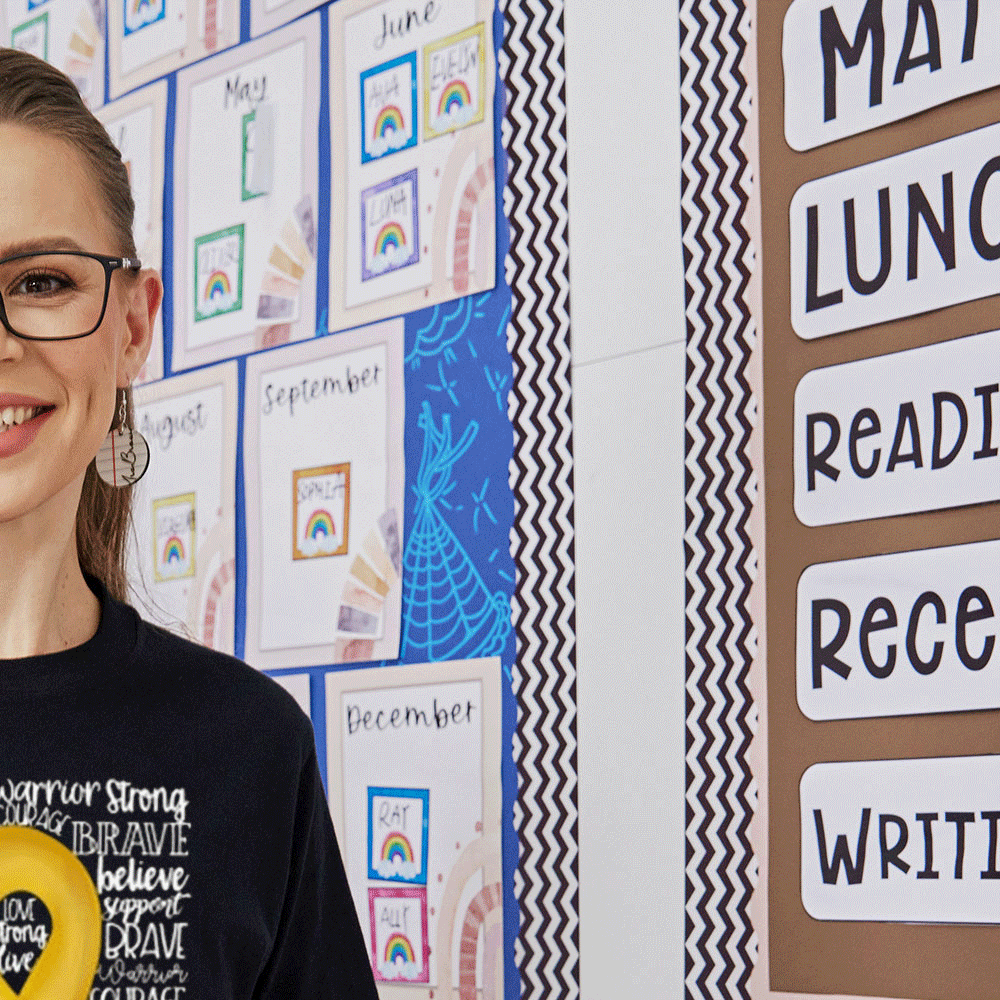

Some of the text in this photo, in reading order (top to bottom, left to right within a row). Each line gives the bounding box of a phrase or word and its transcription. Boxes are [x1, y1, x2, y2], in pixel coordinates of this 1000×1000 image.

[224, 74, 267, 110] May
[262, 363, 383, 417] September
[140, 402, 207, 450] August
[346, 699, 476, 735] December
[72, 822, 191, 856] BRAVE
[97, 856, 190, 894] believe
[3, 898, 36, 920] LOVE
[103, 893, 191, 922] support
[105, 922, 188, 959] BRAVE
